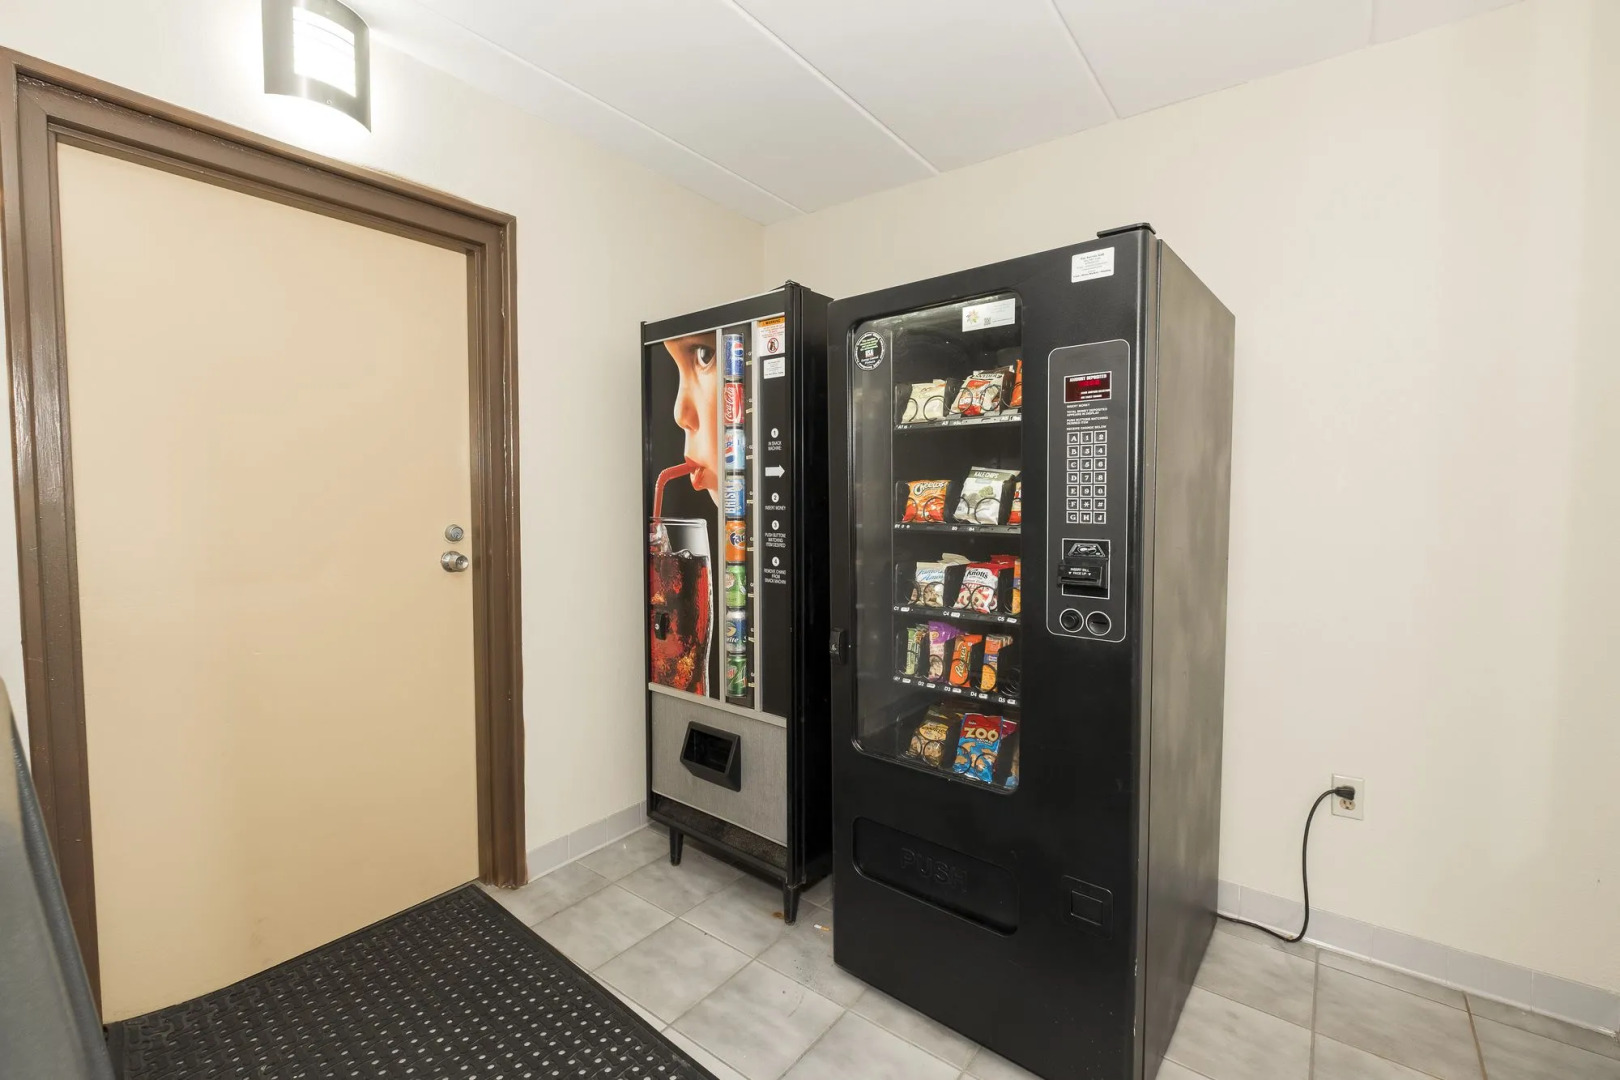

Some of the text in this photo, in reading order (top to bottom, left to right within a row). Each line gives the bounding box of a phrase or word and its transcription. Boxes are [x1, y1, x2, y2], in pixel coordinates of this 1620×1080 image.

[985, 471, 1000, 479] CHIPS
[963, 727, 999, 742] ZOO
[901, 847, 968, 893] PUSH
